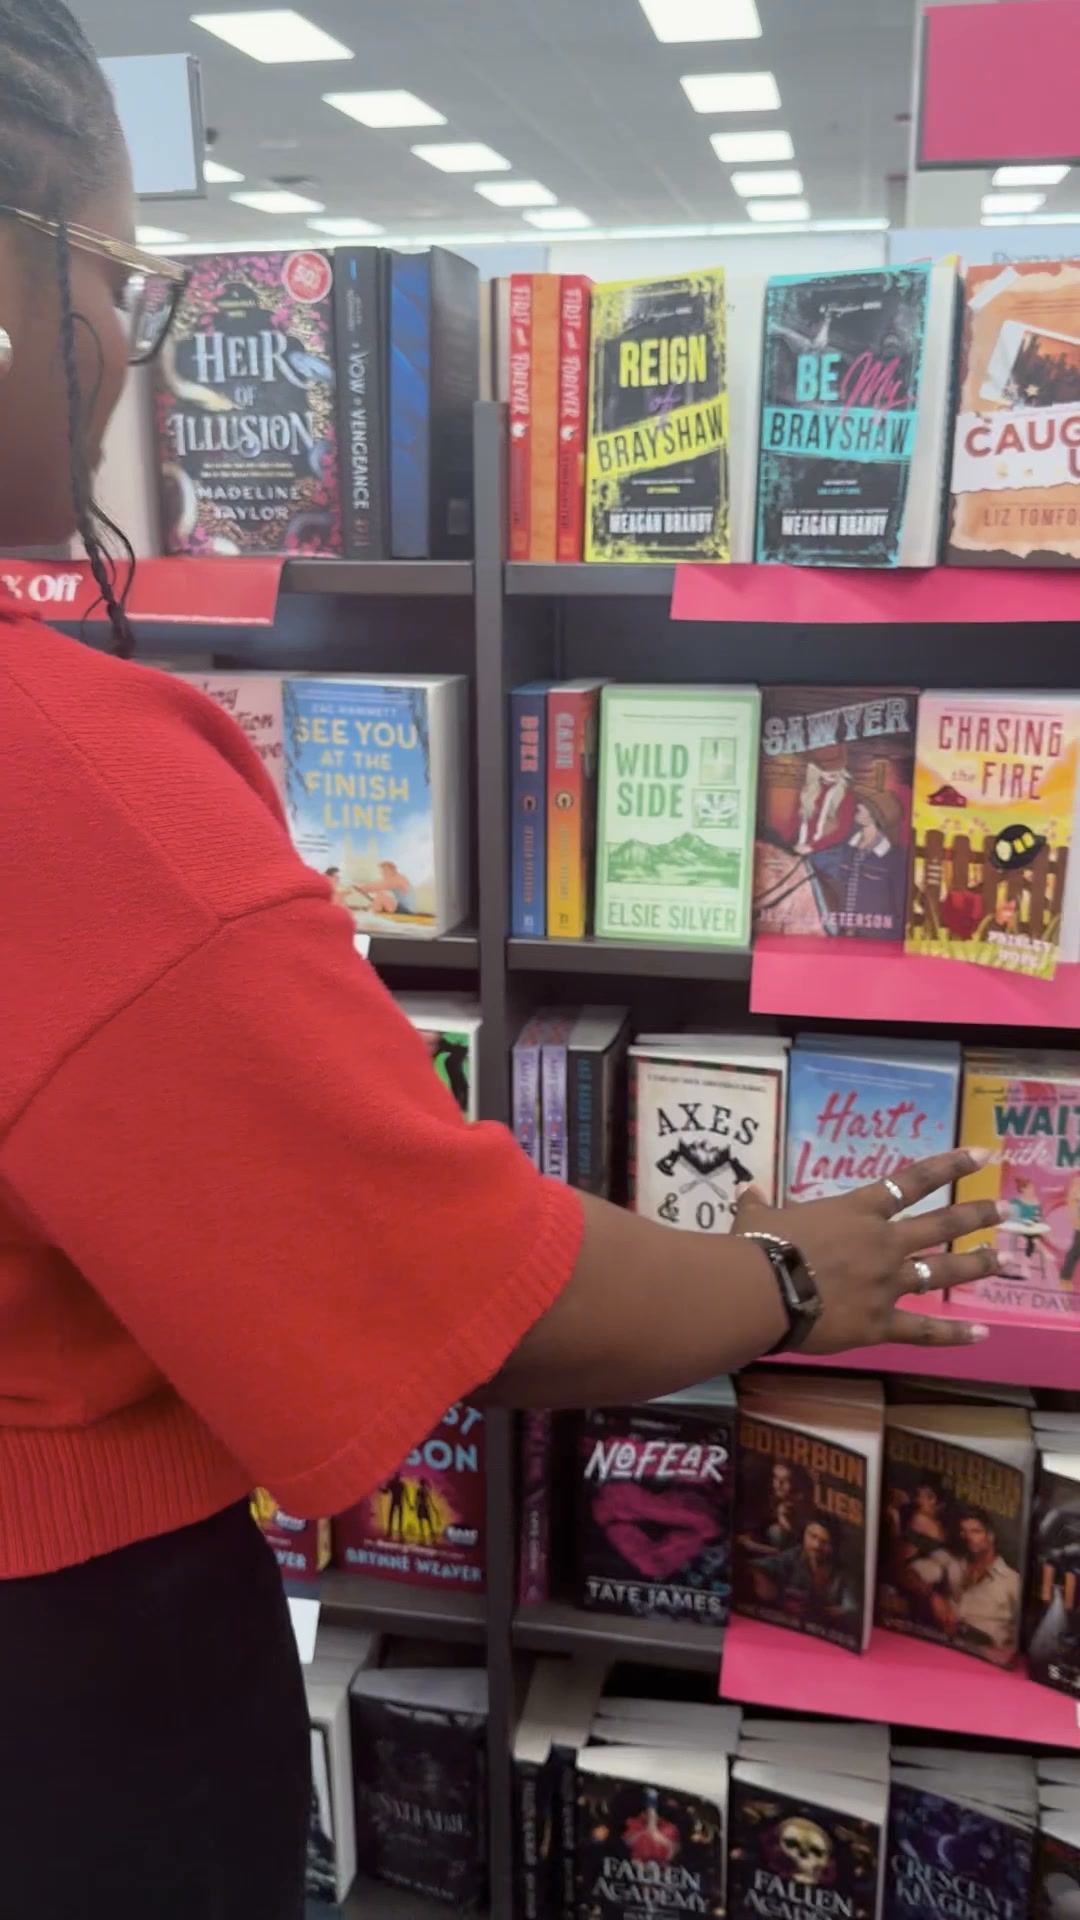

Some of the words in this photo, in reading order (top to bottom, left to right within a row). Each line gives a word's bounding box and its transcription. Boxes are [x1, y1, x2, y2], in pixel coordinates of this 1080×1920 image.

[193, 331, 309, 389] HEIR
[348, 351, 369, 395] VOW
[619, 334, 708, 388] REIGN
[234, 385, 256, 407] OF
[796, 352, 841, 401] BE
[840, 351, 917, 424] My
[167, 411, 314, 458] ILLUSION
[596, 403, 724, 473] BRAYSHAW
[769, 412, 912, 456] BRAYSHAW
[349, 407, 370, 509] VENGEANCE
[198, 485, 301, 500] MADELINE
[213, 505, 289, 521] TAYLOR
[610, 512, 663, 534] MEAGAN
[781, 515, 838, 536] MEAGAN
[983, 508, 1011, 527] LIZ
[1018, 508, 1080, 527] TOMFO
[28, 573, 83, 602] Off
[295, 716, 349, 745] SEE
[354, 721, 418, 749] YOU
[762, 695, 911, 756] SAWYER
[938, 714, 1064, 758] CHASING
[321, 750, 344, 767] AT
[352, 751, 393, 771] THE
[614, 743, 690, 779] WILD
[305, 770, 409, 803] FINISH
[981, 760, 1045, 801] FIRE
[323, 802, 394, 832] LINE
[616, 781, 684, 819] SIDE
[608, 901, 660, 929] ELSIE
[668, 905, 737, 933] SILVER
[655, 1102, 760, 1146] AXES
[816, 1089, 928, 1144] Hart's
[788, 1140, 917, 1193] Landin
[657, 1191, 680, 1223] &
[981, 1286, 1025, 1306] AMY
[634, 1439, 729, 1482] FEAR
[586, 1579, 641, 1603] TATE
[647, 1586, 722, 1613] JAMES
[602, 1855, 700, 1893] FALLEN
[754, 1867, 853, 1917] FALLEN
